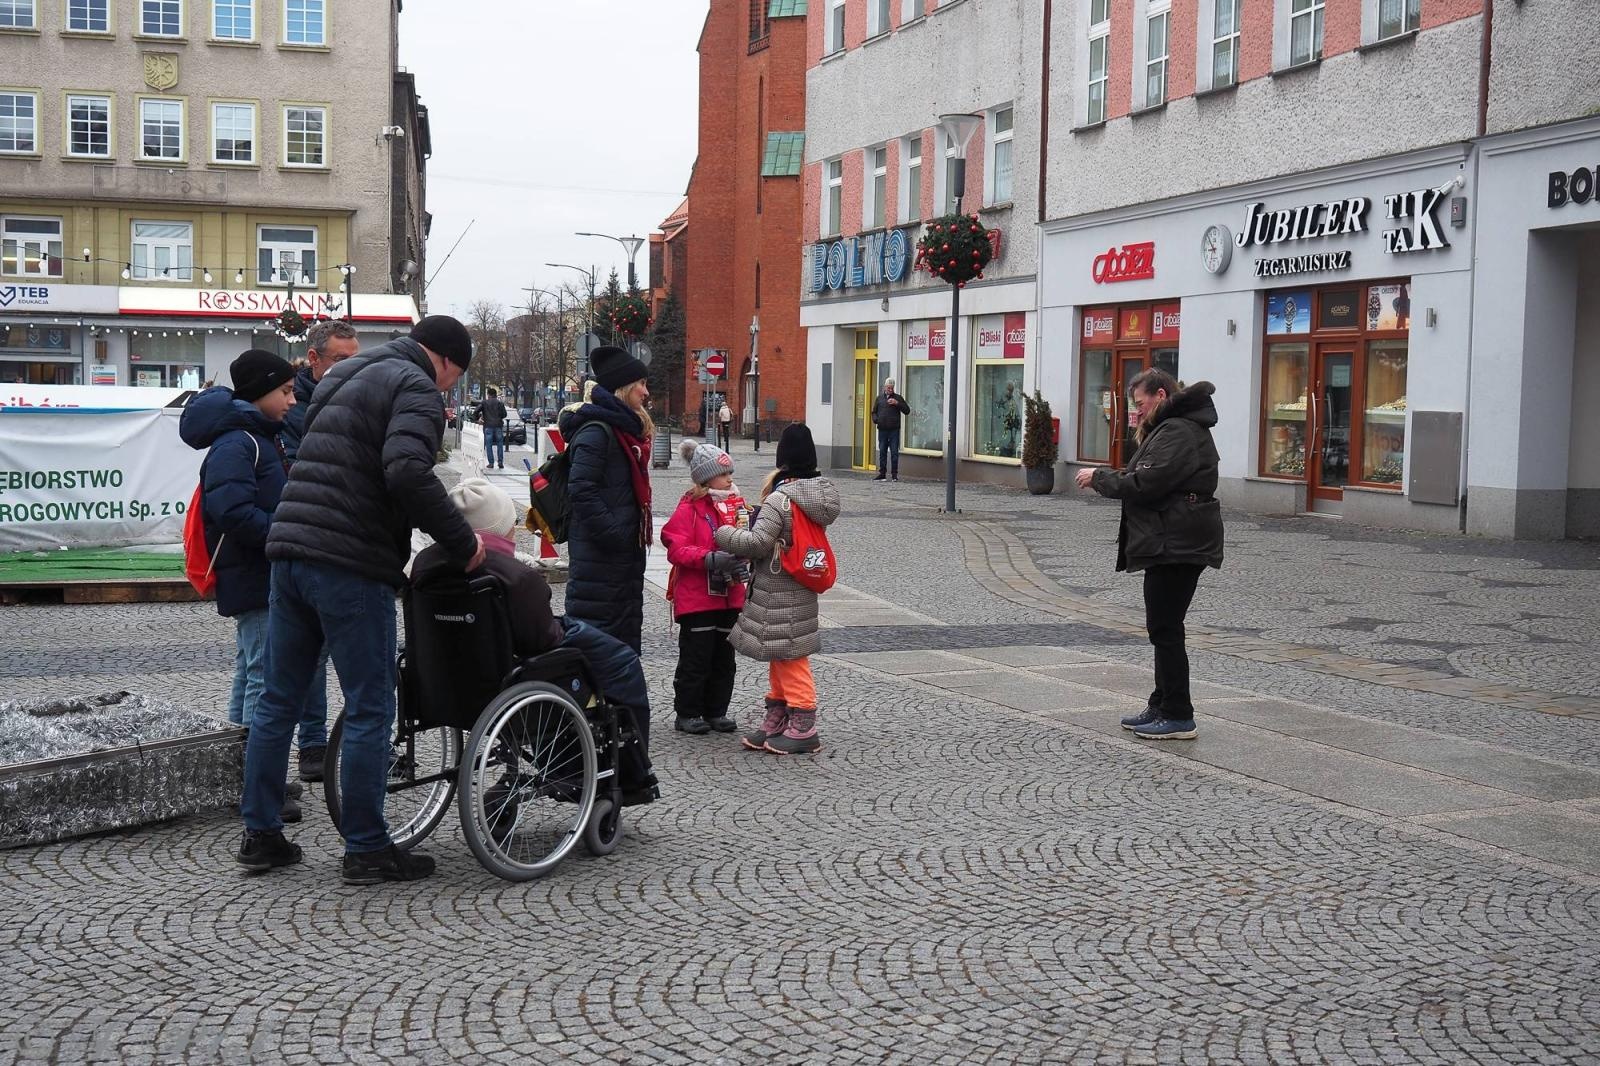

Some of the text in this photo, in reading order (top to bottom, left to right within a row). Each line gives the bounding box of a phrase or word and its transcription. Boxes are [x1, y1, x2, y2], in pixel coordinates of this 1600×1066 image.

[1235, 197, 1371, 249] JUBILER
[812, 228, 910, 292] BOLKO
[1254, 252, 1349, 278] ZEGARMISTRZ
[19, 287, 49, 298] TEB
[199, 291, 333, 312] ROSSMANN
[0, 501, 124, 522] ROGOWYCH
[129, 499, 156, 521] Sp.
[161, 501, 171, 515] z
[803, 549, 828, 570] 32
